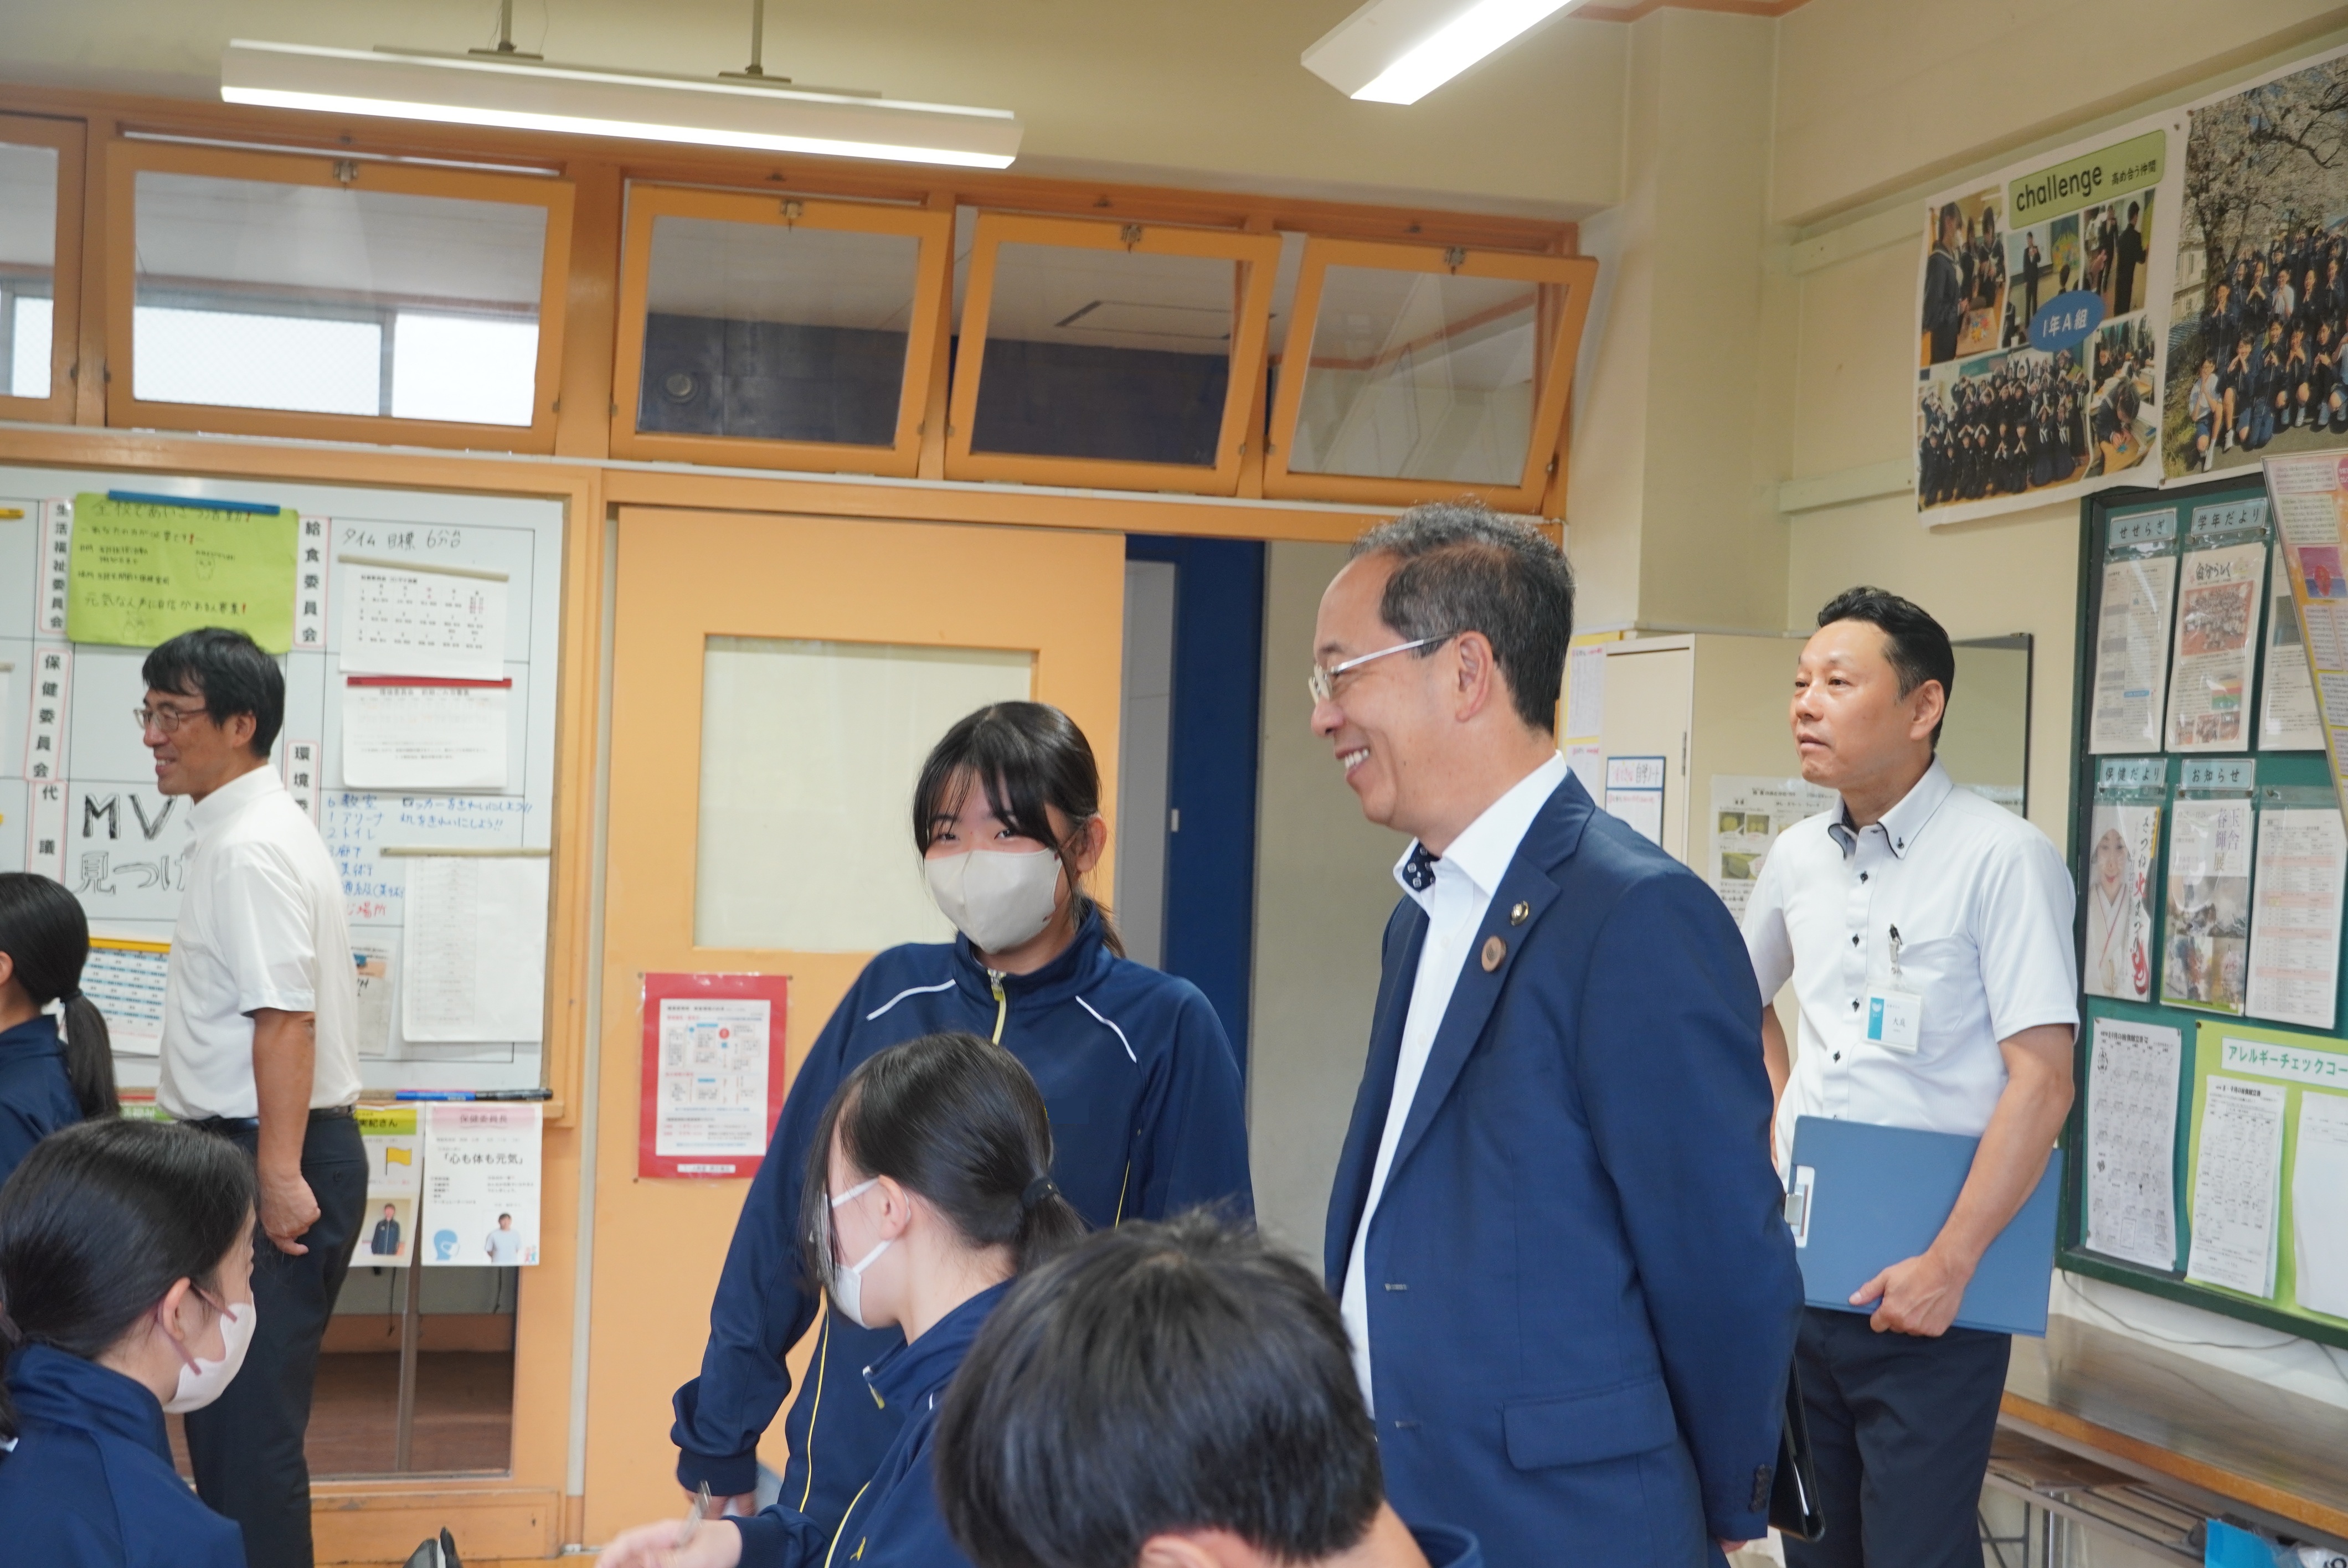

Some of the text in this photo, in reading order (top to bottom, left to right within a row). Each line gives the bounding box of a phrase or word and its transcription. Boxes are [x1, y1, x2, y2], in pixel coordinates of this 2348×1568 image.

[2016, 159, 2156, 212] challenge 高め合う仲間
[2043, 308, 2087, 338] 1年A組
[2120, 519, 2165, 539] せせらぎ
[2198, 508, 2259, 530] 学年だより
[388, 530, 415, 550] 目標
[50, 503, 69, 628] 生活福祉委員会
[2196, 562, 2231, 580] 自分らしく
[302, 521, 321, 642] 給食委員会
[33, 654, 60, 778] 保健委員会
[2106, 766, 2160, 782] 保健だより
[2192, 768, 2239, 783] お知らせ
[343, 826, 375, 840] トイレ
[2228, 1045, 2348, 1076] アレルギーチェックコー
